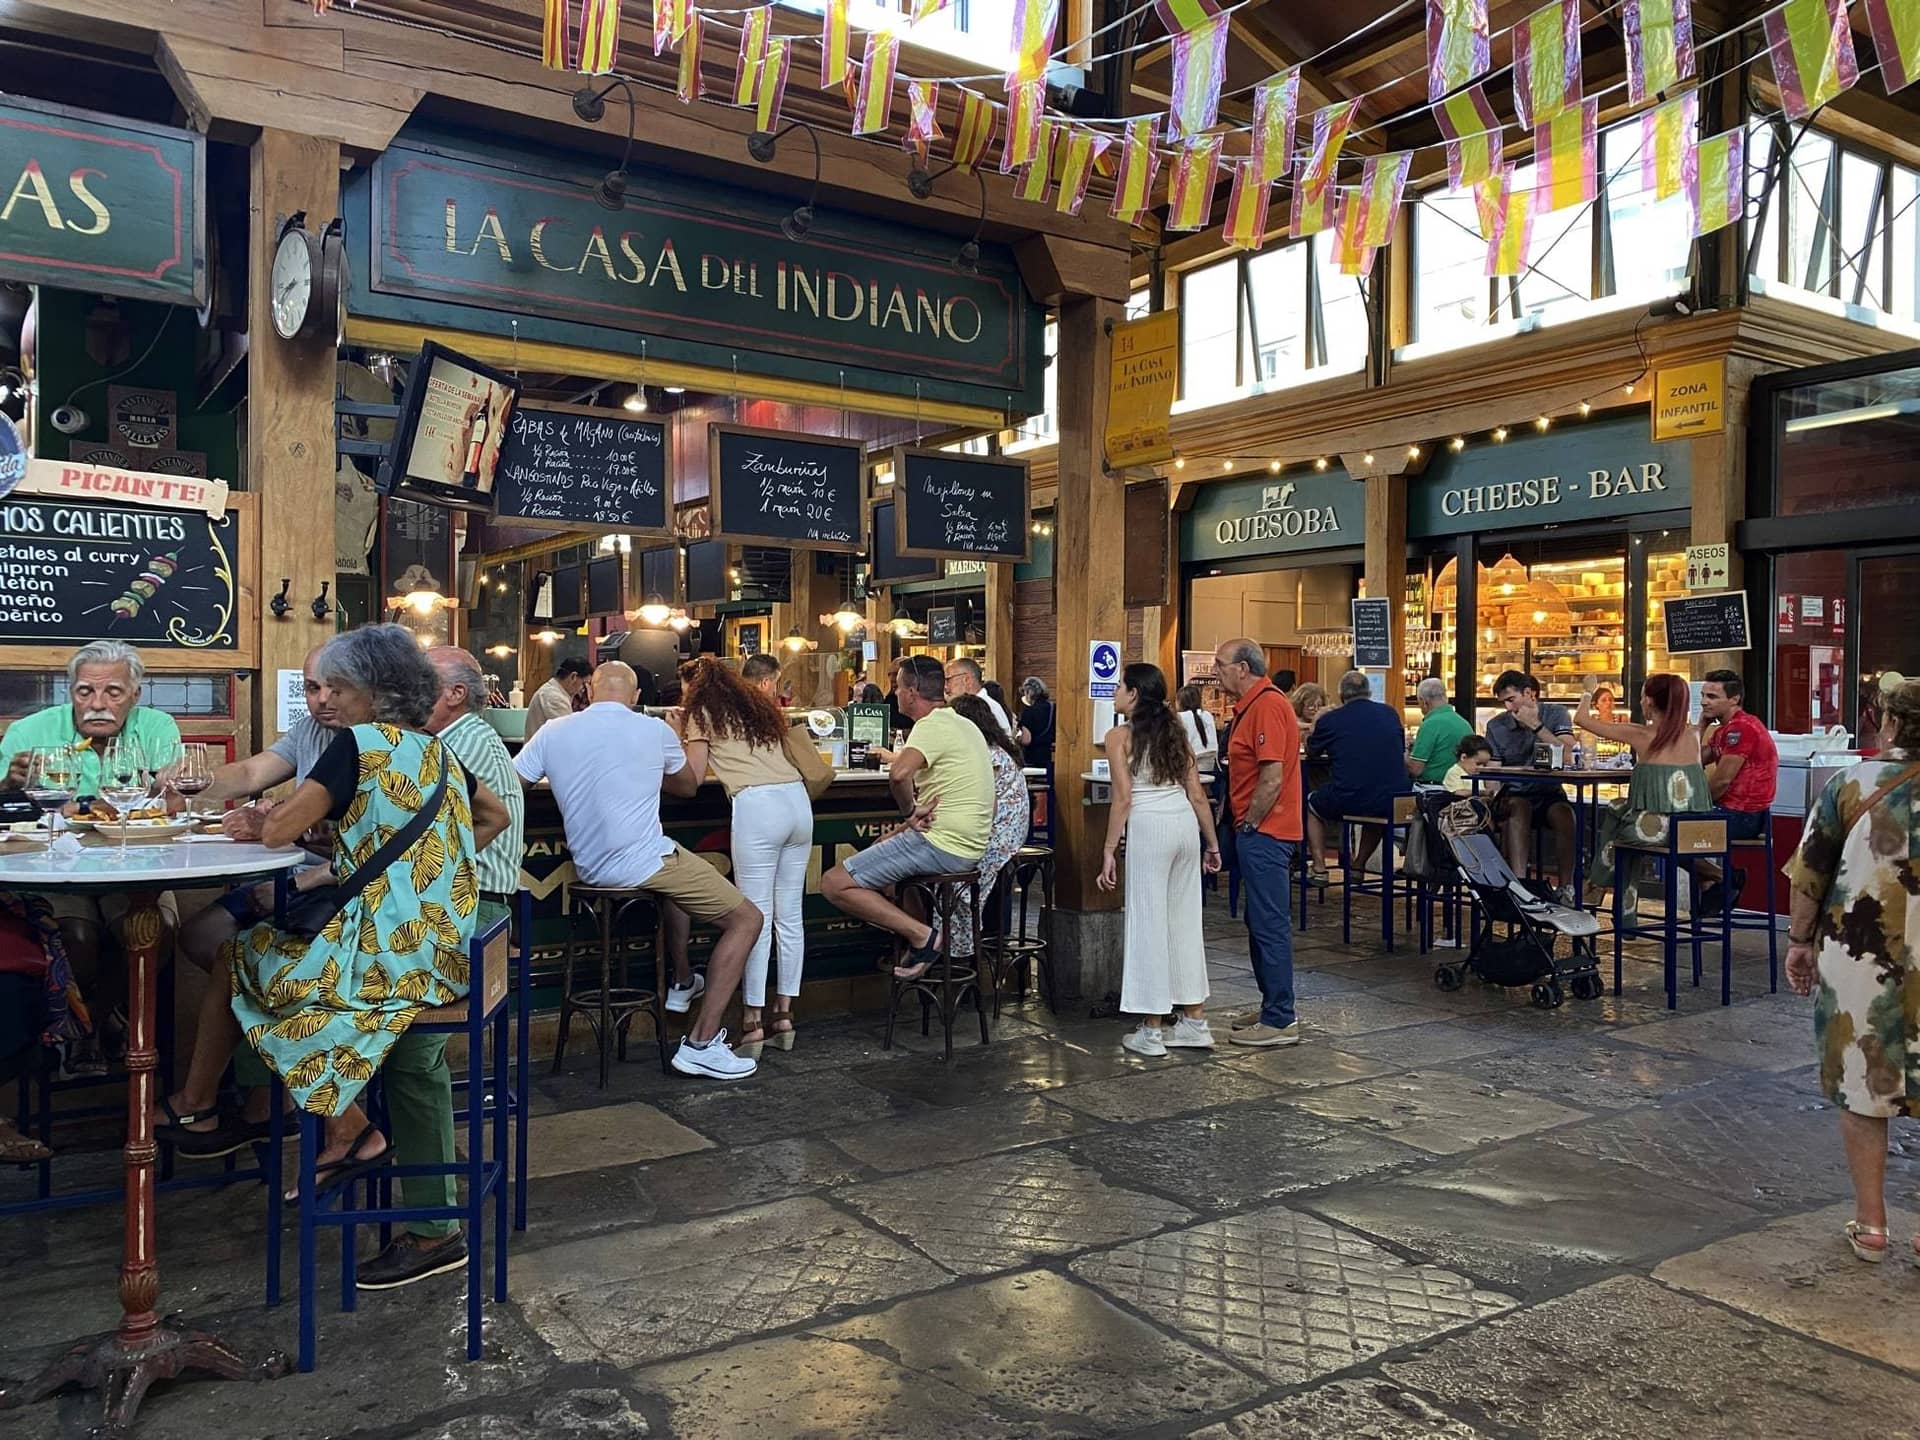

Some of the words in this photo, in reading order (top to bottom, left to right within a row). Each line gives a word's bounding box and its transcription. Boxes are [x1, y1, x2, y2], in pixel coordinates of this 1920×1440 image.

[445, 198, 512, 263] LA
[527, 215, 688, 293] CASA
[701, 252, 764, 299] DEL
[776, 259, 983, 344] INDIANO
[1670, 382, 1708, 398] ZONA
[1660, 400, 1719, 419] INFANTIL
[118, 423, 170, 444] GALLETAS
[59, 466, 206, 505] PICANTE!
[759, 477, 775, 497] 1/2
[1441, 475, 1562, 517] CHEESE
[1587, 462, 1668, 500] BAR
[518, 504, 527, 516] 1
[531, 503, 565, 518] Ración
[759, 497, 770, 513] 1
[940, 502, 979, 521] Salsa
[1215, 505, 1341, 545] QUESOBA
[64, 546, 83, 563] al
[88, 550, 141, 566] curry
[1688, 546, 1726, 561] ASEOS
[853, 706, 864, 717] LA
[864, 707, 884, 718] CASA
